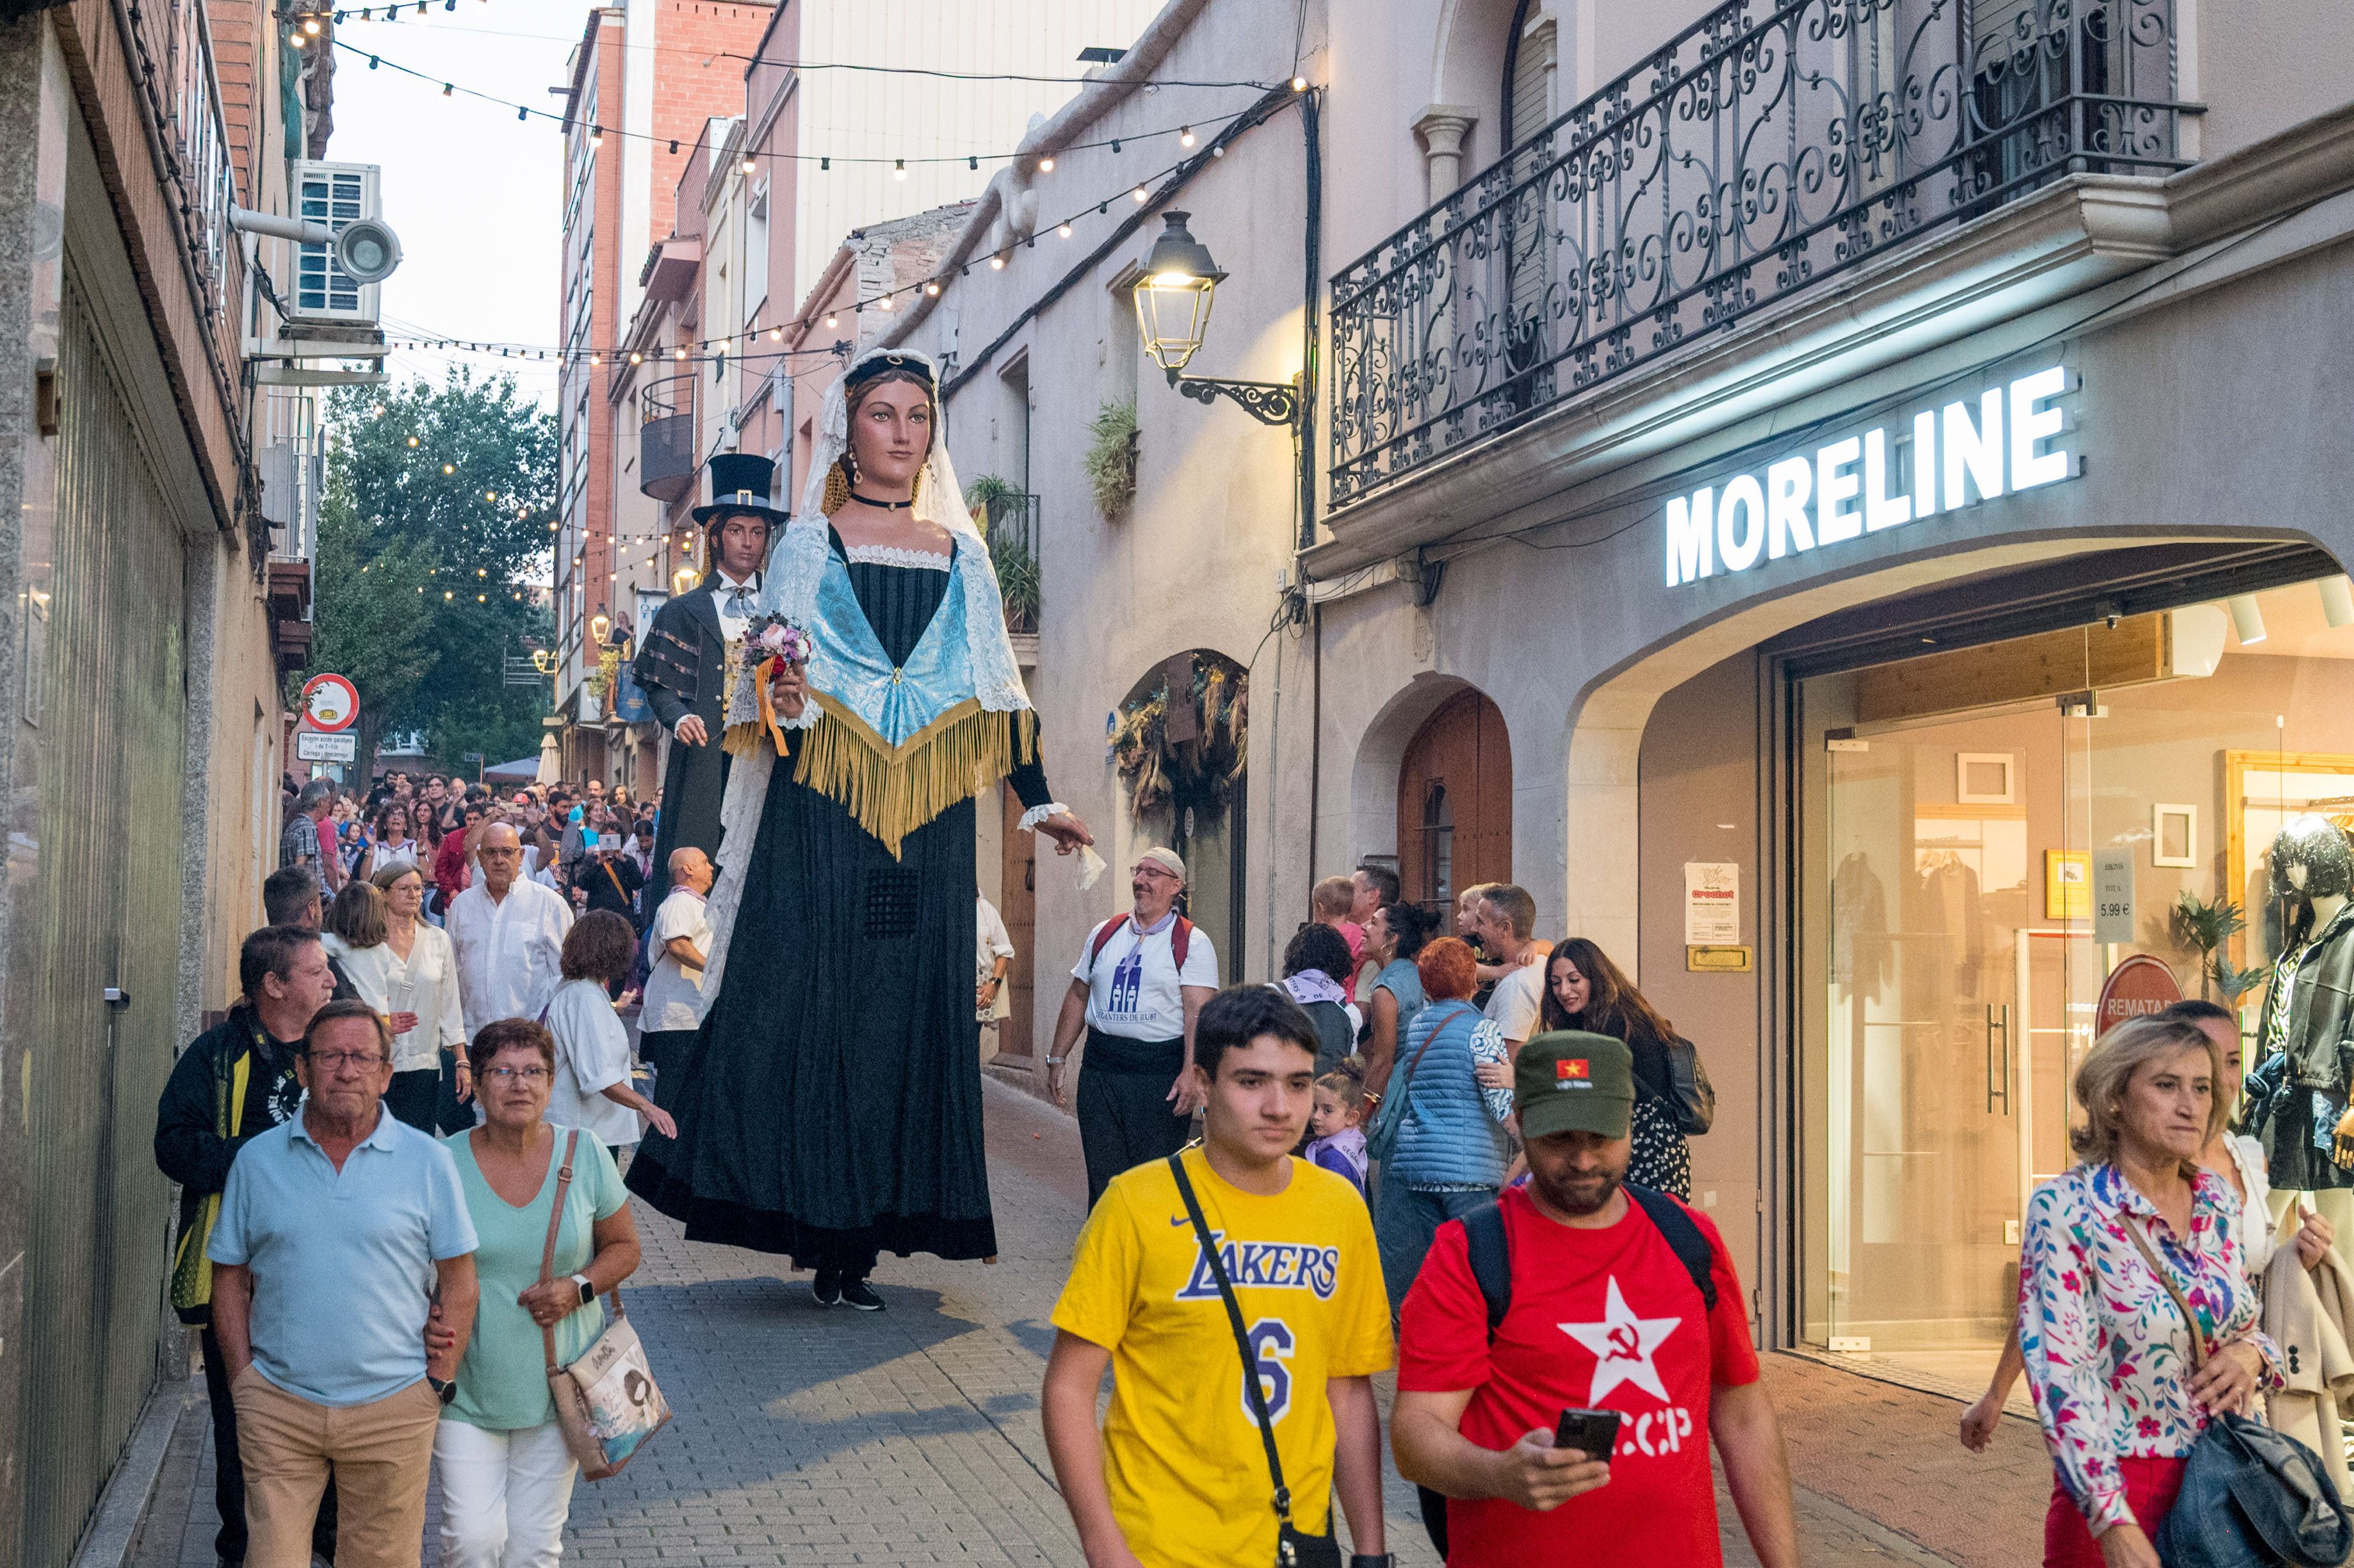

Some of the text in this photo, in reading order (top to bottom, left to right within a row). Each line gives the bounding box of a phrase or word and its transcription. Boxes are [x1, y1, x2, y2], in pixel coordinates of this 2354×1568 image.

[1666, 366, 2068, 588] MORELINE
[1692, 890, 1733, 898] Crochet
[2100, 903, 2129, 916] 5.99 €
[2107, 999, 2180, 1017] REMATA
[1130, 1014, 1139, 1022] DE
[1174, 1229, 1338, 1302] LAKERS
[1240, 1317, 1295, 1434] 6
